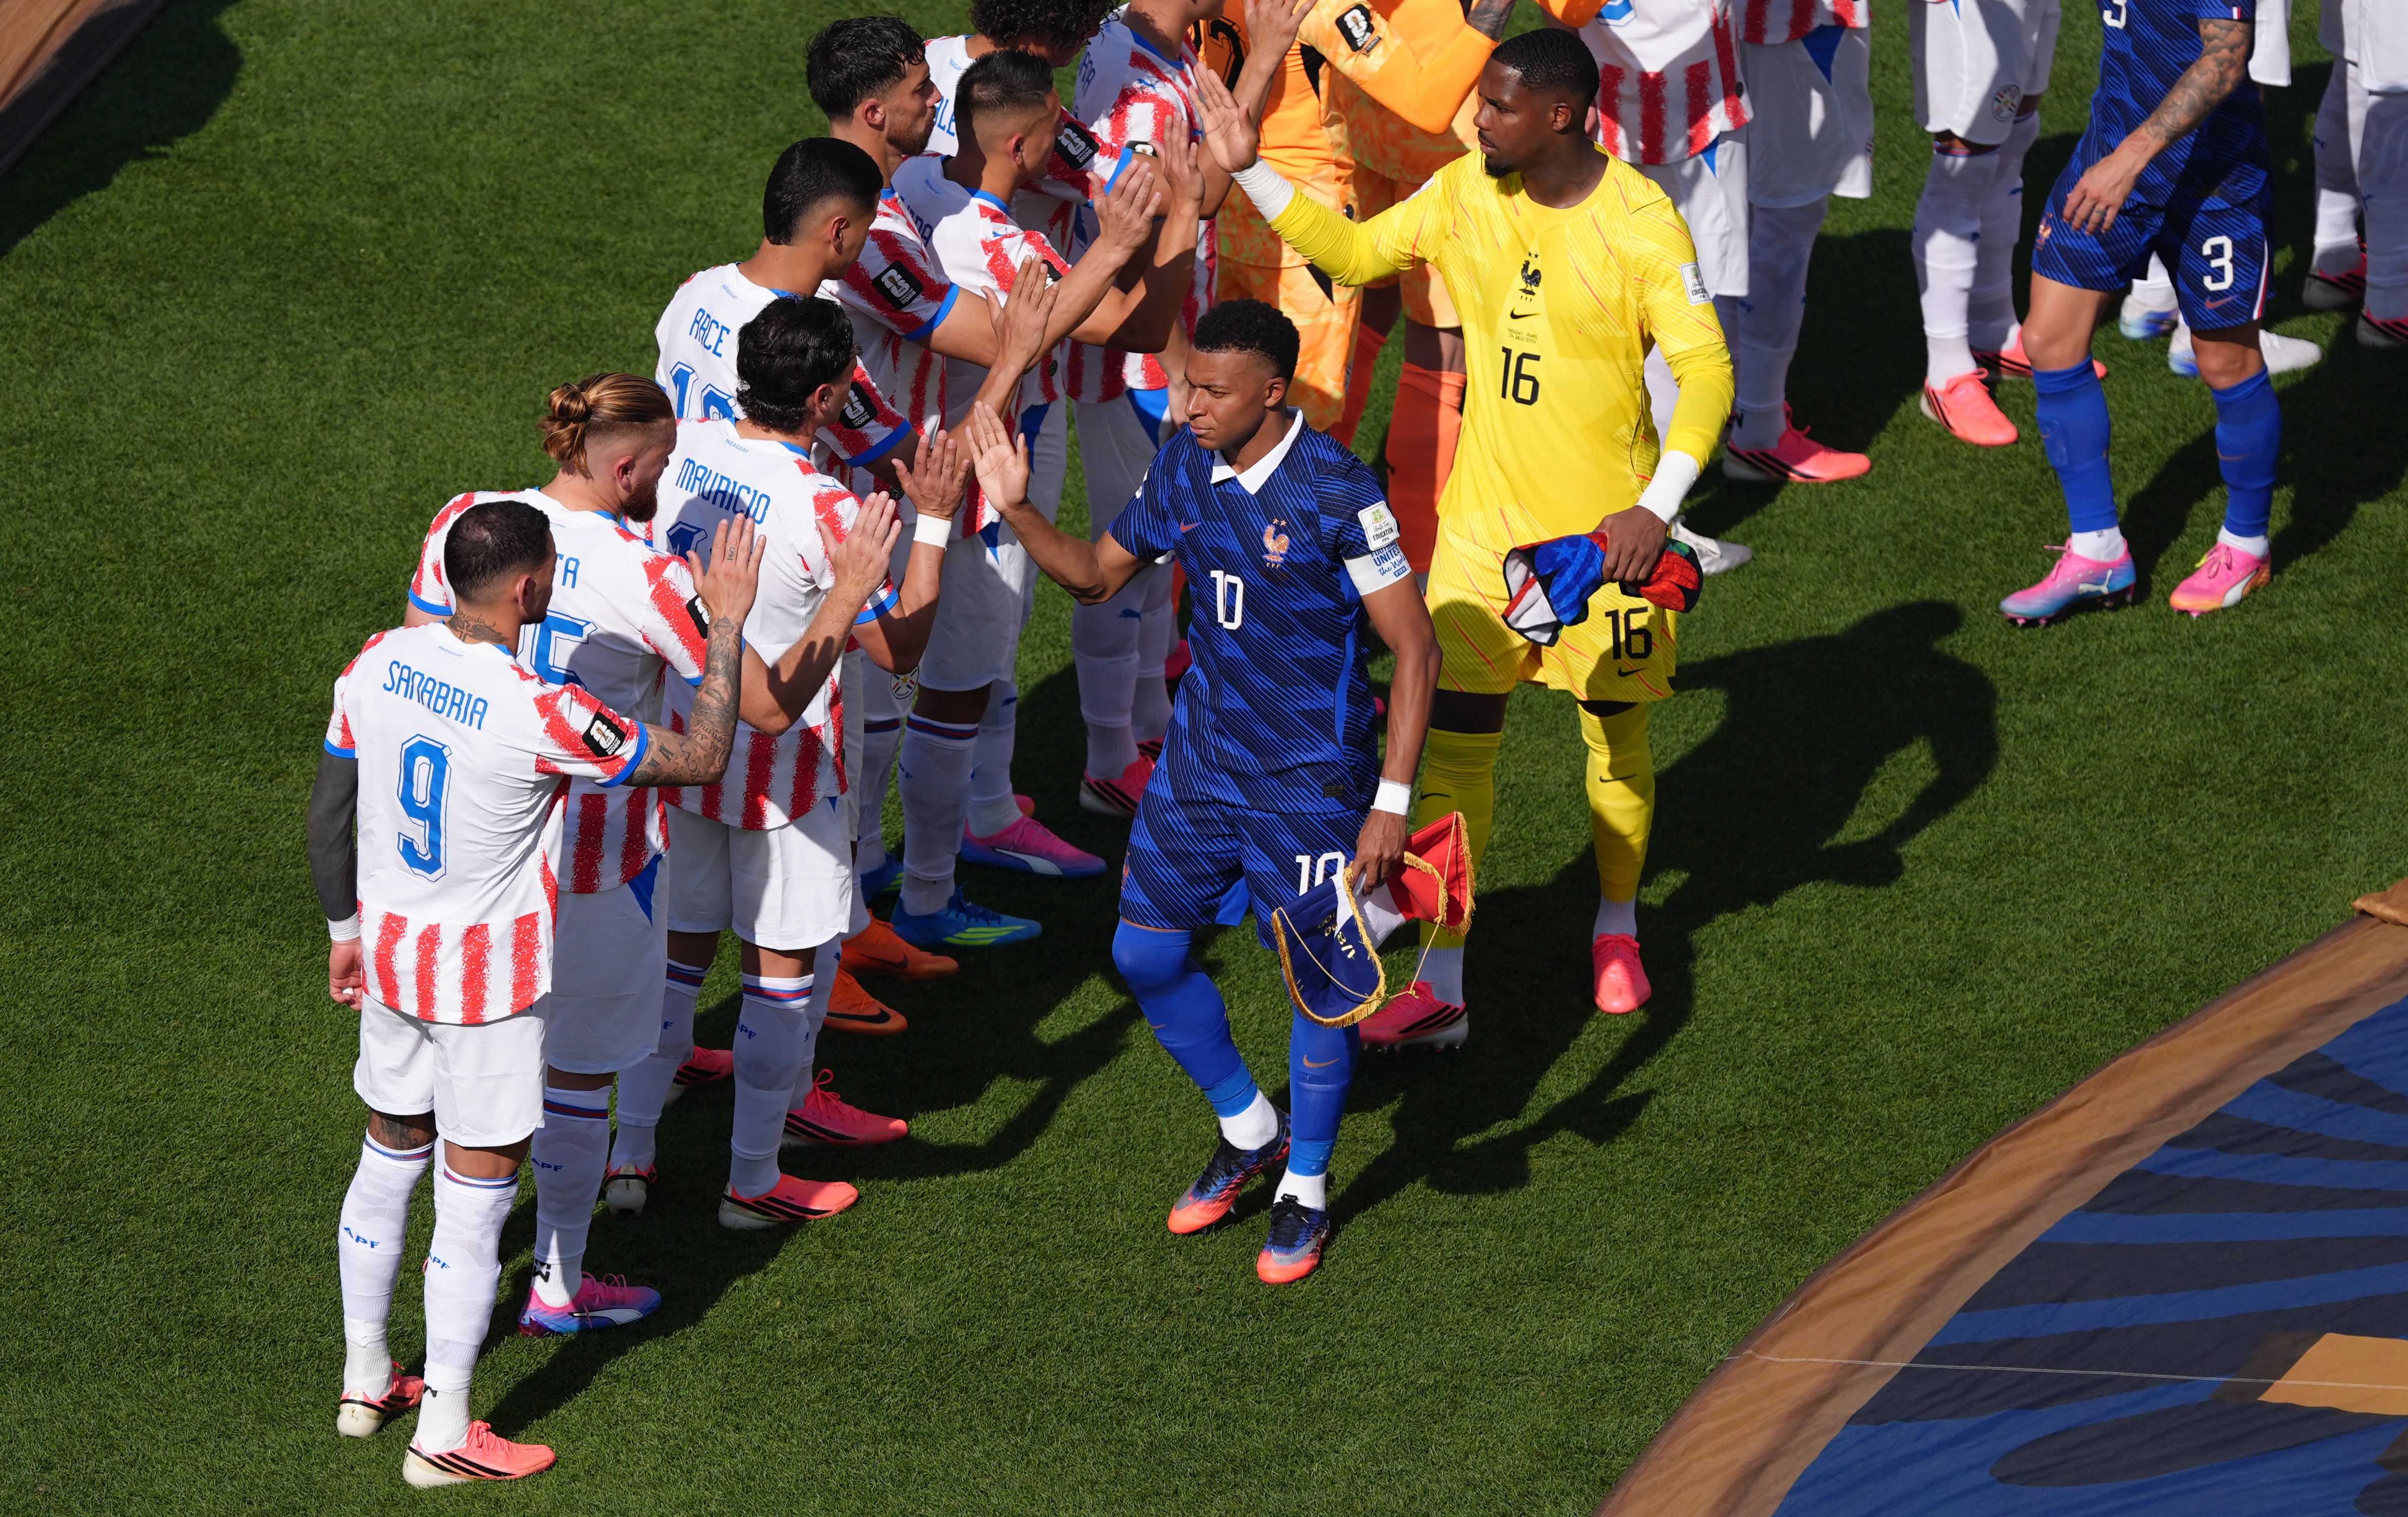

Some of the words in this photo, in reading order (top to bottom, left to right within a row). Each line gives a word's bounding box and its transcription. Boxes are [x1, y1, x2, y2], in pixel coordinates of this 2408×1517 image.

[2202, 235, 2233, 291] 3
[721, 284, 738, 299] PARAGUAY
[901, 290, 917, 304] 2026
[689, 307, 732, 358] ARCE
[1507, 327, 1523, 336] PARAGUAY
[1501, 346, 1541, 406] 16
[854, 414, 870, 426] 2026
[724, 439, 750, 454] PARAGUAY
[676, 457, 771, 525] MAURICIO
[1372, 526, 1394, 541] EDUCATION
[1373, 544, 1401, 567] UNITES
[1377, 566, 1392, 576] the
[1389, 553, 1406, 569] World
[1210, 570, 1244, 630] 10
[1605, 606, 1653, 660] 16
[437, 645, 464, 658] PARAGUAY
[382, 660, 488, 731] SANABRIA
[607, 739, 621, 756] 2026
[397, 733, 453, 883] 9
[1296, 851, 1346, 897] 10
[531, 1157, 564, 1172] APF
[344, 1227, 380, 1249] APF
